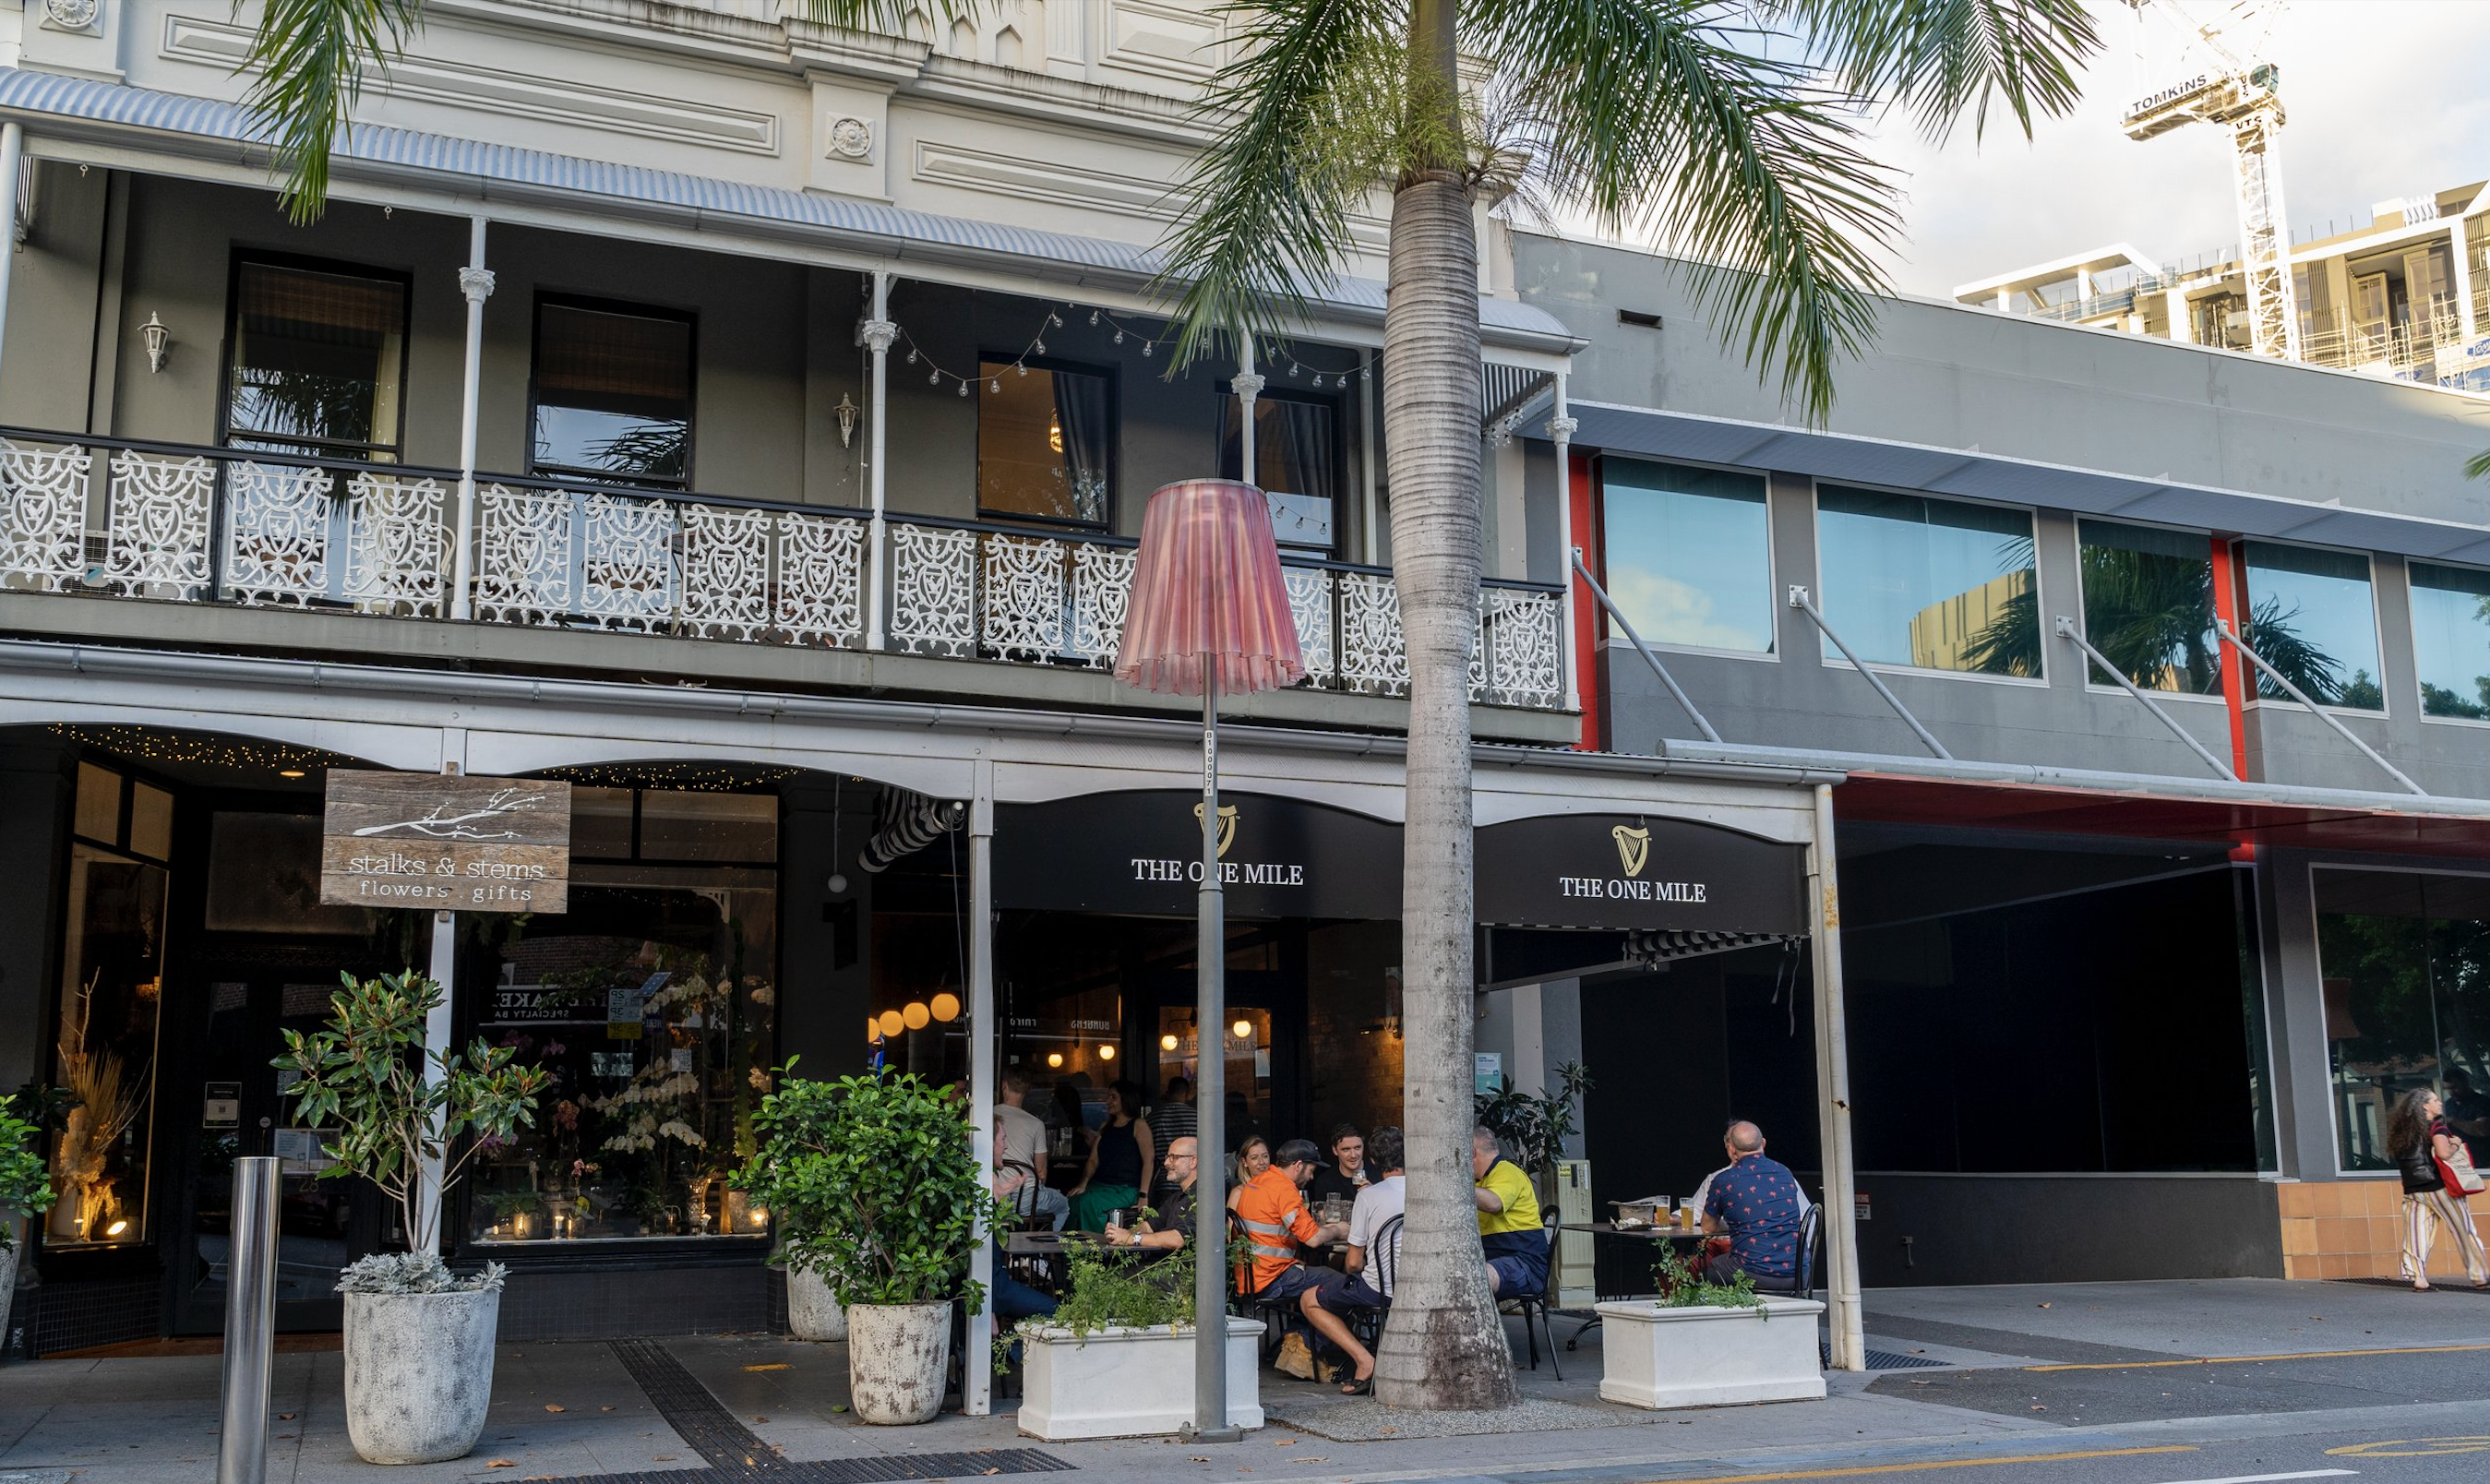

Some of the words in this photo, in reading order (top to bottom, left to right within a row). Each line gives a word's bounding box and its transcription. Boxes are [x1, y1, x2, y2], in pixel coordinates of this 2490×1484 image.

[2236, 115, 2262, 130] VTS
[349, 854, 425, 876] stalks
[436, 857, 455, 877] &
[466, 860, 544, 880] stems
[1131, 858, 1182, 881] THE
[1244, 863, 1304, 885] MILE
[361, 880, 449, 898] flowers
[472, 885, 532, 903] gifts
[1560, 877, 1604, 897] THE
[1608, 879, 1651, 900] ONE
[1655, 881, 1706, 903] MILE
